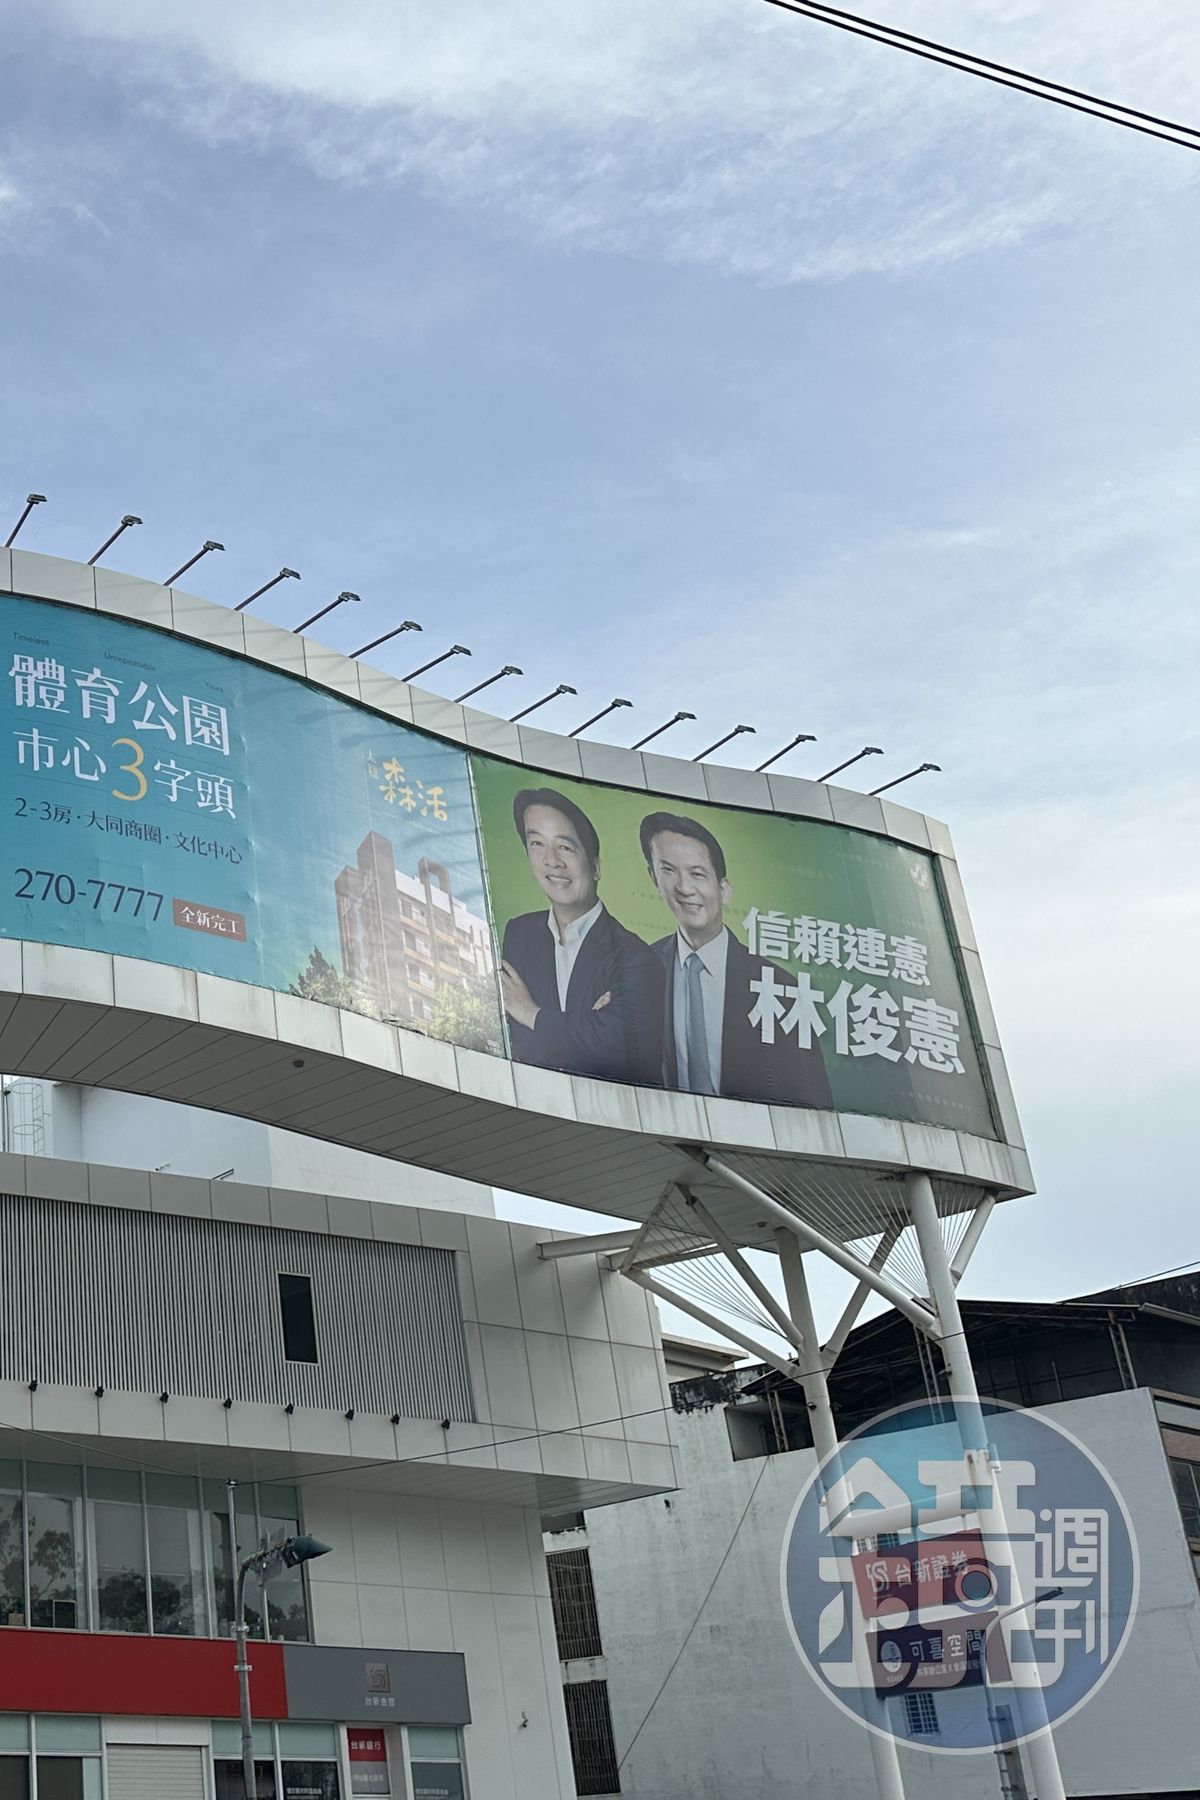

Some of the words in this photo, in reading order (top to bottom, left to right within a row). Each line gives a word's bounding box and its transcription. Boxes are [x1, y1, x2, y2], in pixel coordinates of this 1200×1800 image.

[13, 632, 50, 646] Timeless
[8, 654, 230, 756] 體育公園
[13, 728, 237, 819] 市心3字頭
[15, 868, 164, 922] 270-7777
[180, 906, 242, 935] 全新完工
[742, 906, 931, 987] 信賴連憲
[748, 966, 966, 1074] 林俊憲
[895, 1550, 970, 1588] 台新證券
